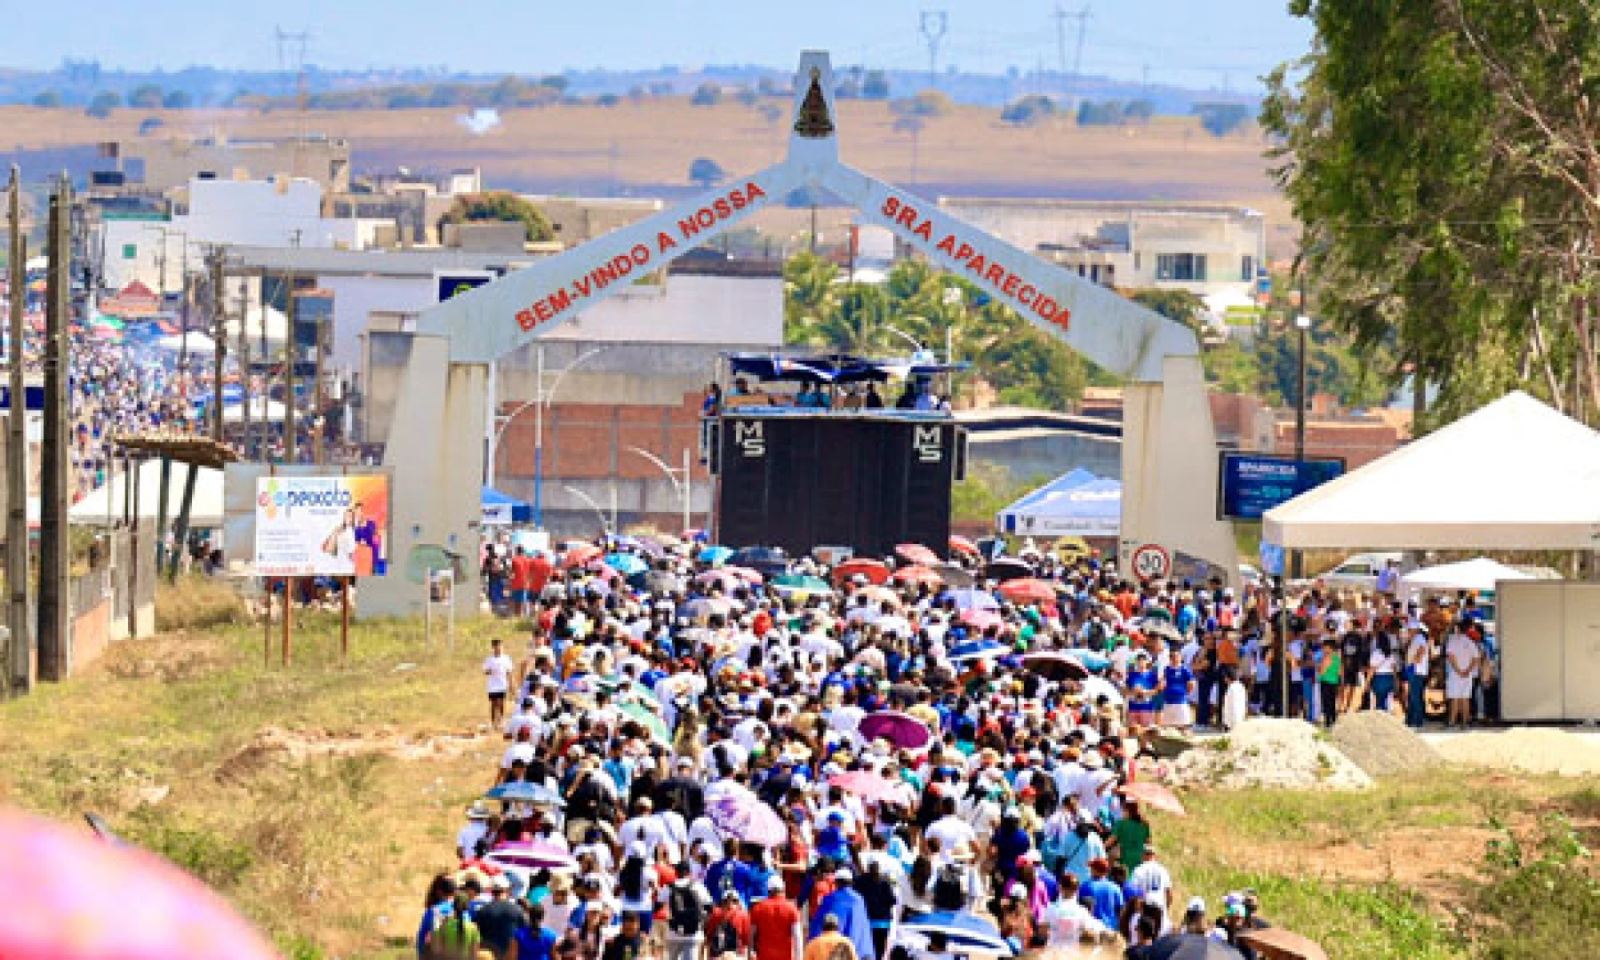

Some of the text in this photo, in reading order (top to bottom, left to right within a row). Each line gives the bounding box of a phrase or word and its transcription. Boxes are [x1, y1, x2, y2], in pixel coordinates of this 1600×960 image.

[515, 182, 766, 332] BEM-VINDO A NOSSA
[882, 196, 1071, 331] SRA APARECIDA
[1139, 552, 1162, 571] 30
